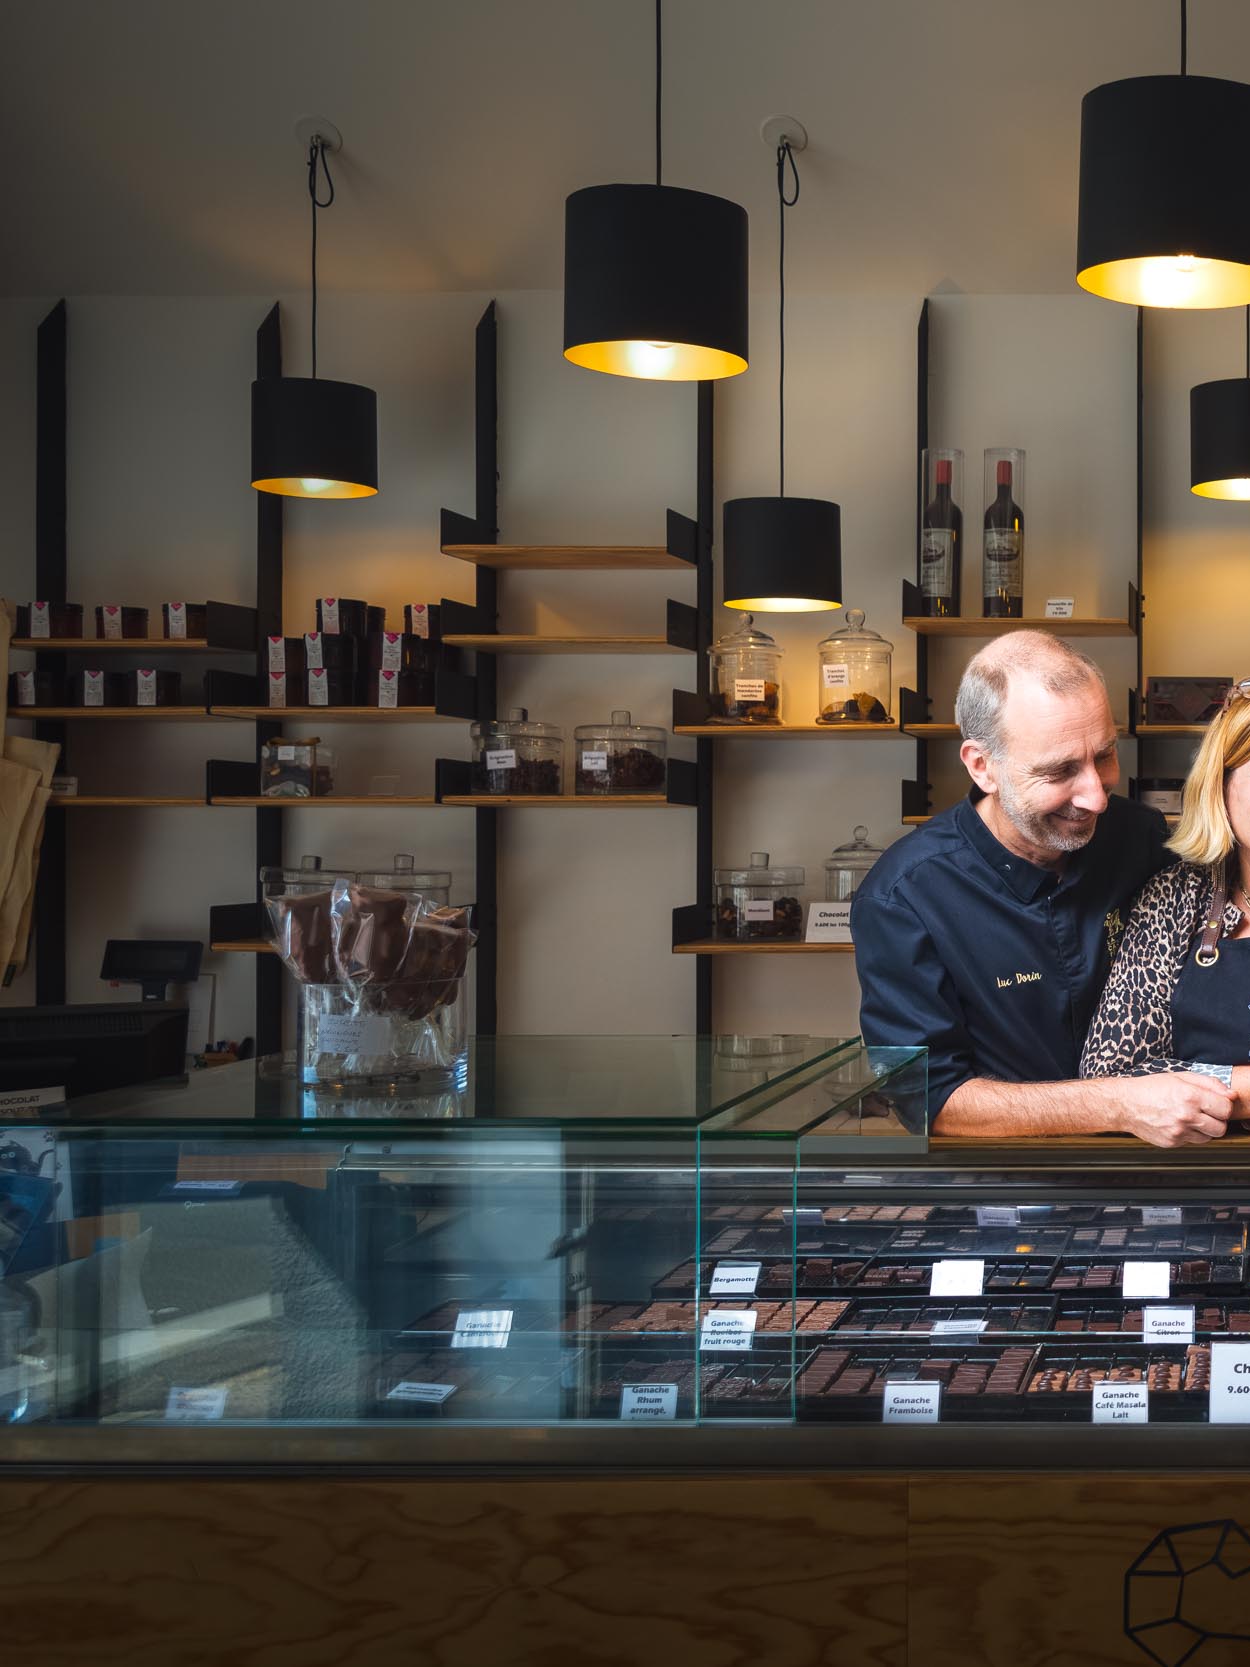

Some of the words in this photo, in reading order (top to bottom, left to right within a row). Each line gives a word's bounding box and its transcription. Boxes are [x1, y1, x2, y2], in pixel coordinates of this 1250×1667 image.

[996, 976, 1013, 989] Luc
[1016, 971, 1043, 984] Dorin
[631, 1385, 670, 1394] Ganache
[1102, 1391, 1140, 1399] Ganache
[636, 1396, 663, 1404] Rhum
[892, 1396, 931, 1404] Ganache
[1095, 1401, 1115, 1409] Café
[1116, 1401, 1146, 1409] Masala
[888, 1407, 934, 1415] Framboise
[1112, 1411, 1129, 1419] Lait
